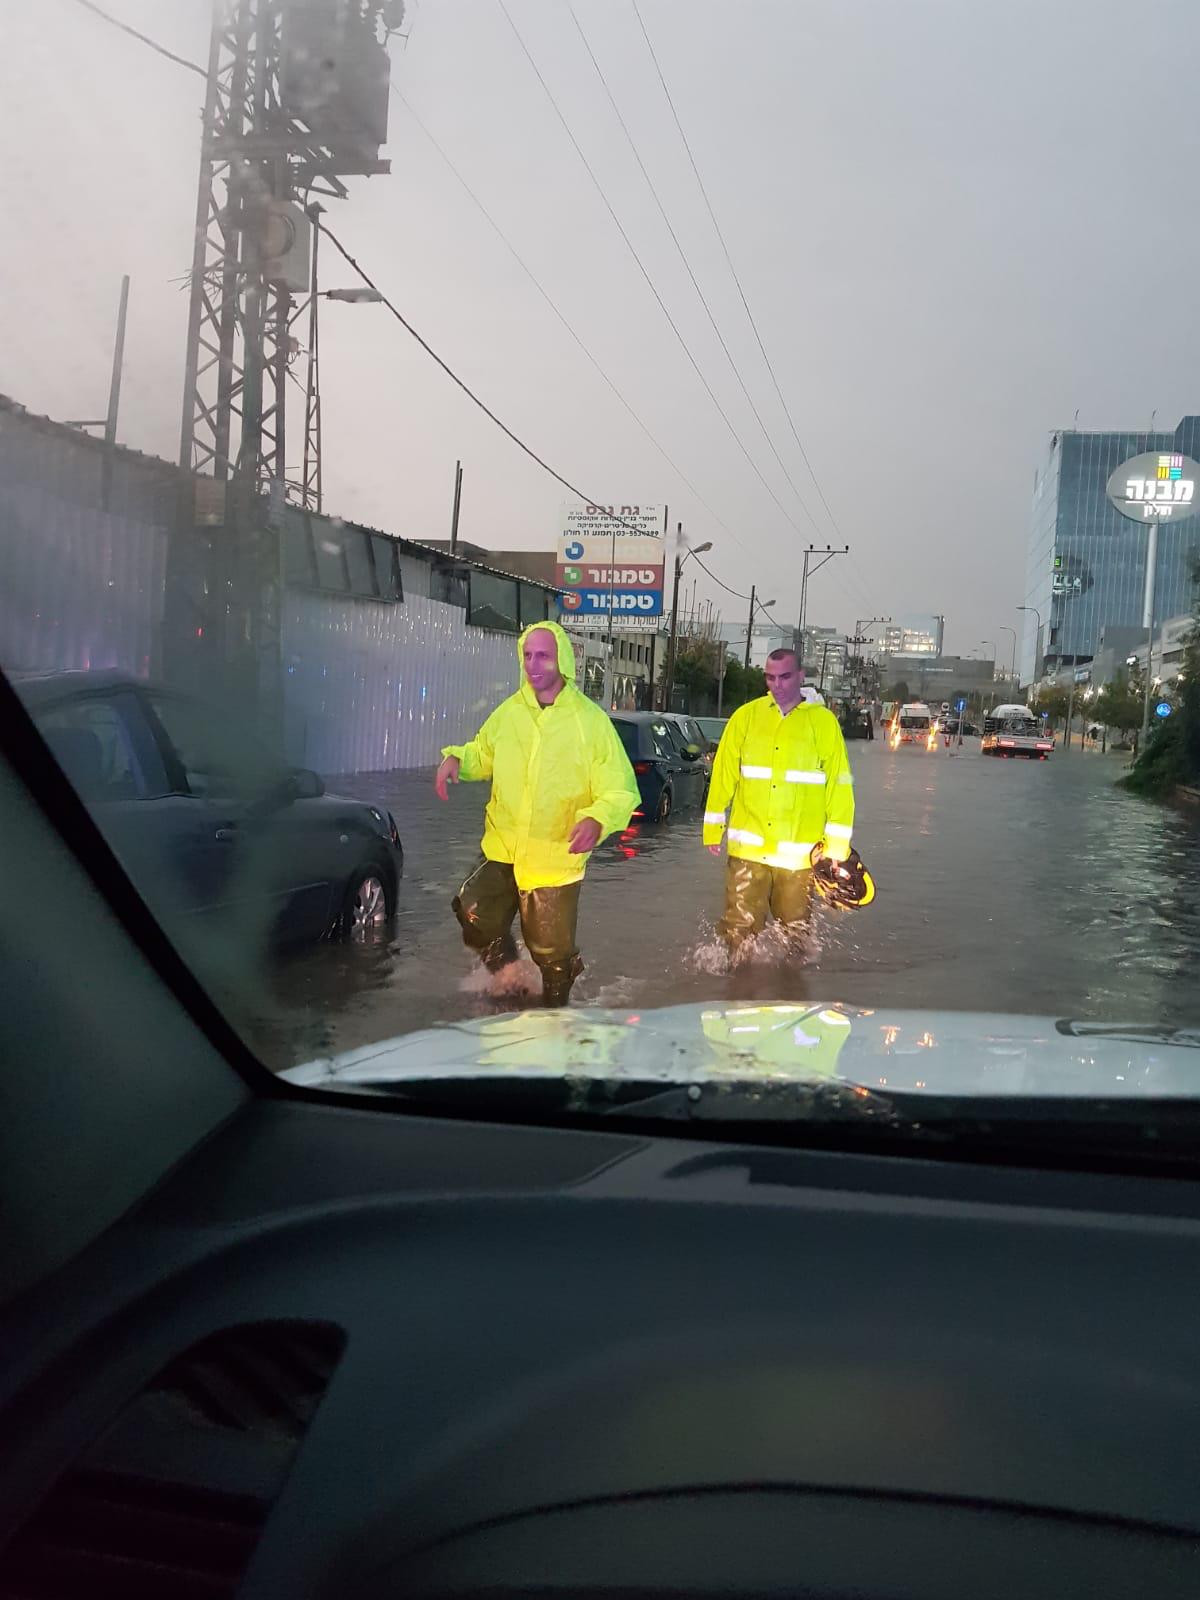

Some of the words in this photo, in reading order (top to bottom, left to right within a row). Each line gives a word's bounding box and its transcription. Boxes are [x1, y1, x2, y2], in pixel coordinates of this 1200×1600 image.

[1125, 480, 1194, 501] מבנה
[563, 529, 581, 537] חולון
[588, 569, 656, 584] טמבור
[586, 593, 655, 609] טמבור
